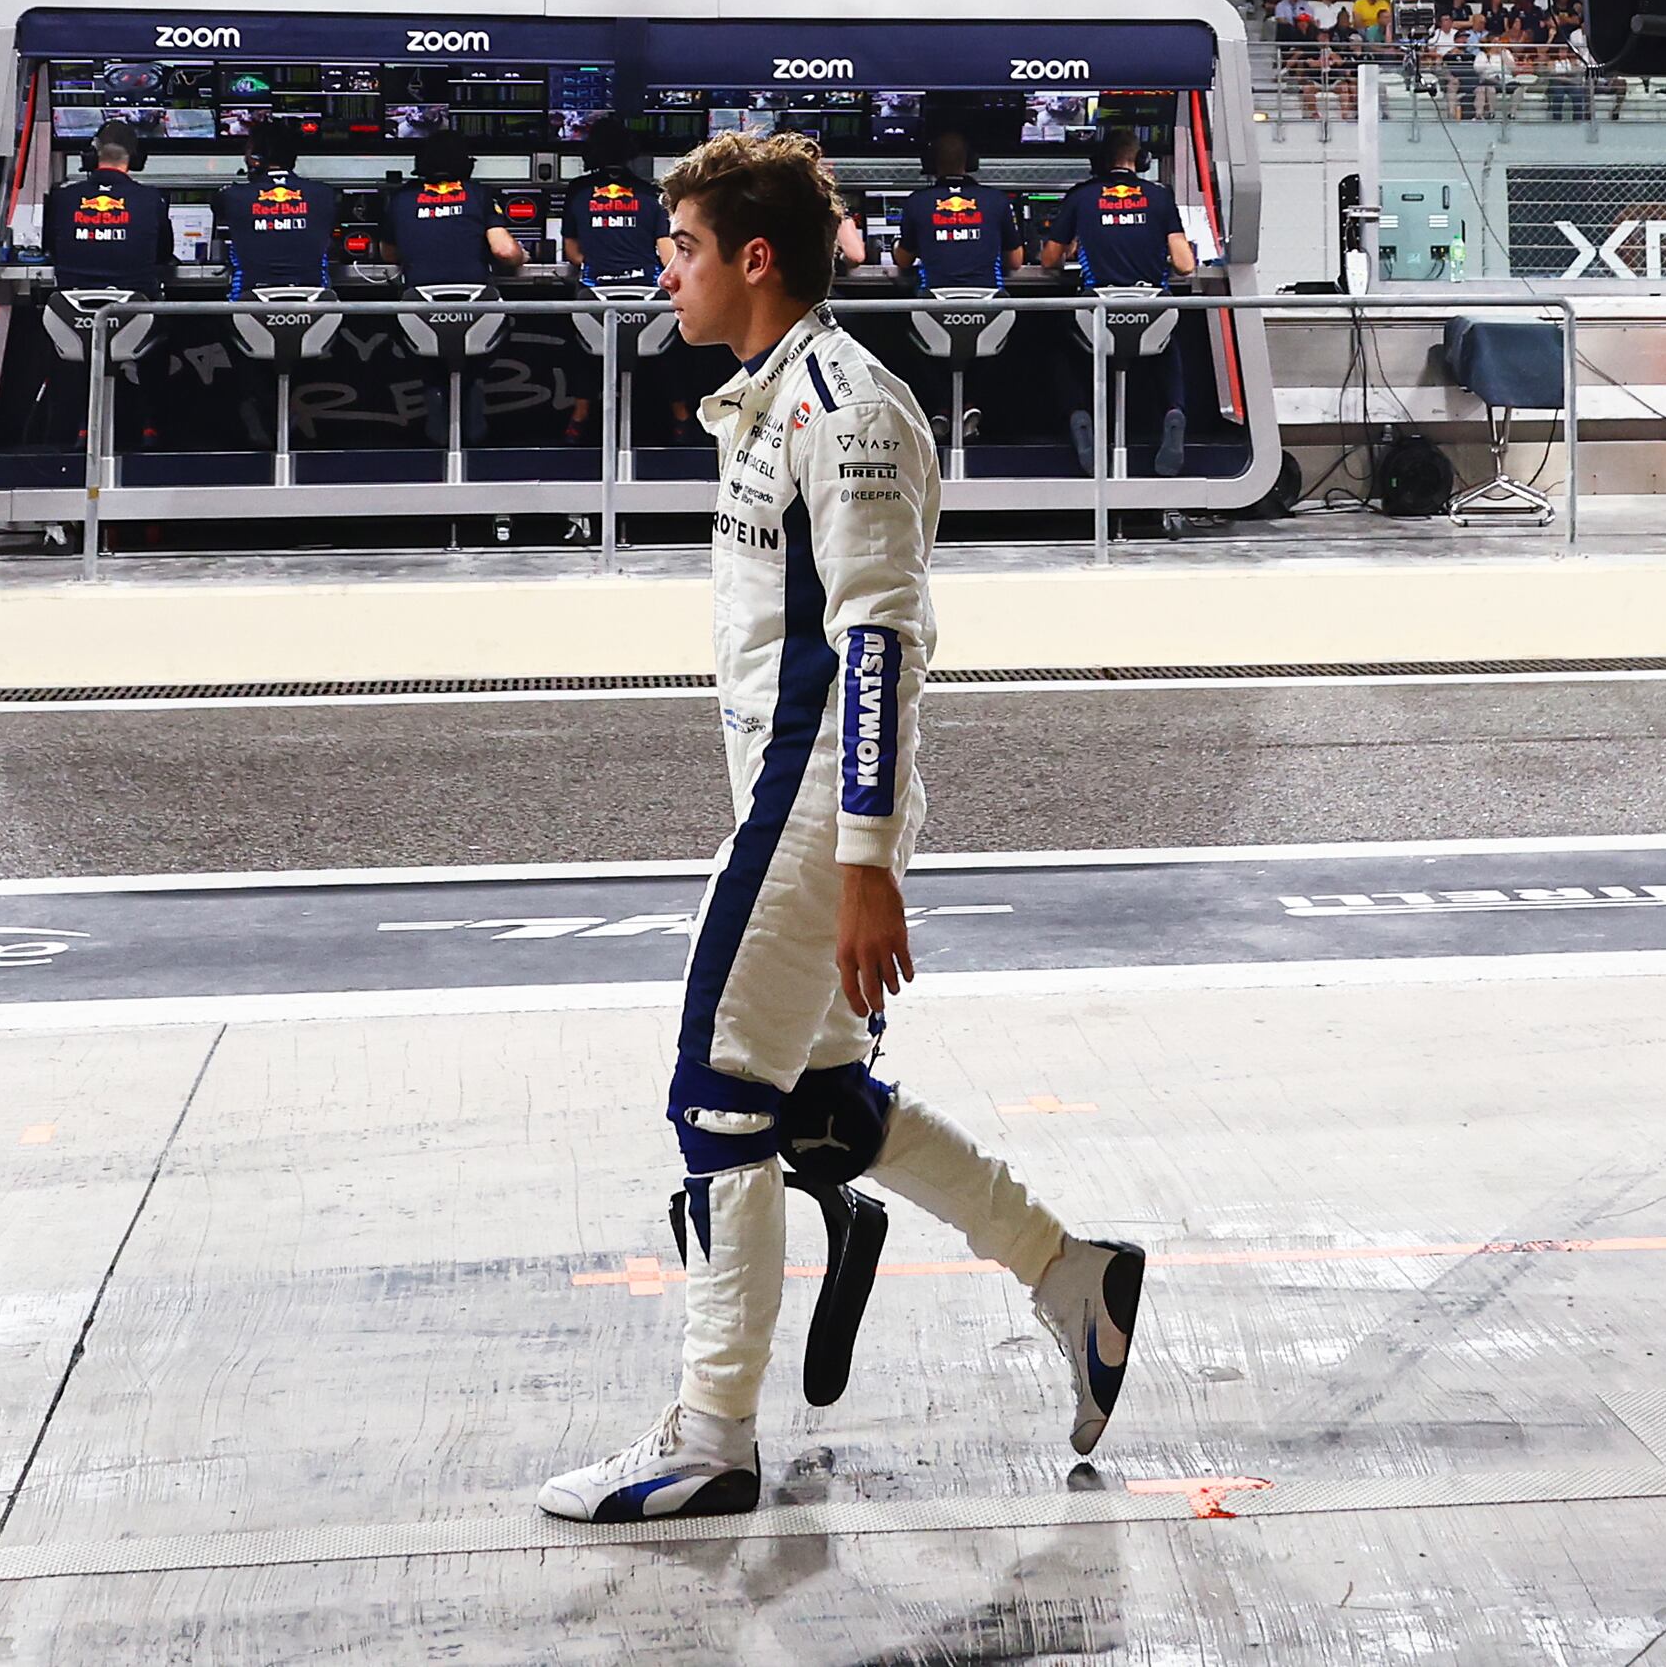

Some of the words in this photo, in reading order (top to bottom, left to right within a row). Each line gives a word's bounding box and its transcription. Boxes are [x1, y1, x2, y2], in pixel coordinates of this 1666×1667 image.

[155, 26, 241, 48] zoom
[406, 30, 490, 51] zoom
[773, 58, 854, 79] zoom
[1010, 59, 1089, 80] zoom
[74, 316, 120, 329] zom
[266, 313, 311, 326] zoom
[612, 312, 647, 325] oom
[943, 312, 986, 325] zoom
[1107, 312, 1149, 325] zoom
[767, 334, 814, 384] MYPROTEIN
[858, 439, 900, 451] VAST
[736, 450, 775, 480] DACELL
[851, 490, 901, 501] KEEPER
[854, 633, 885, 787] KOMATSU
